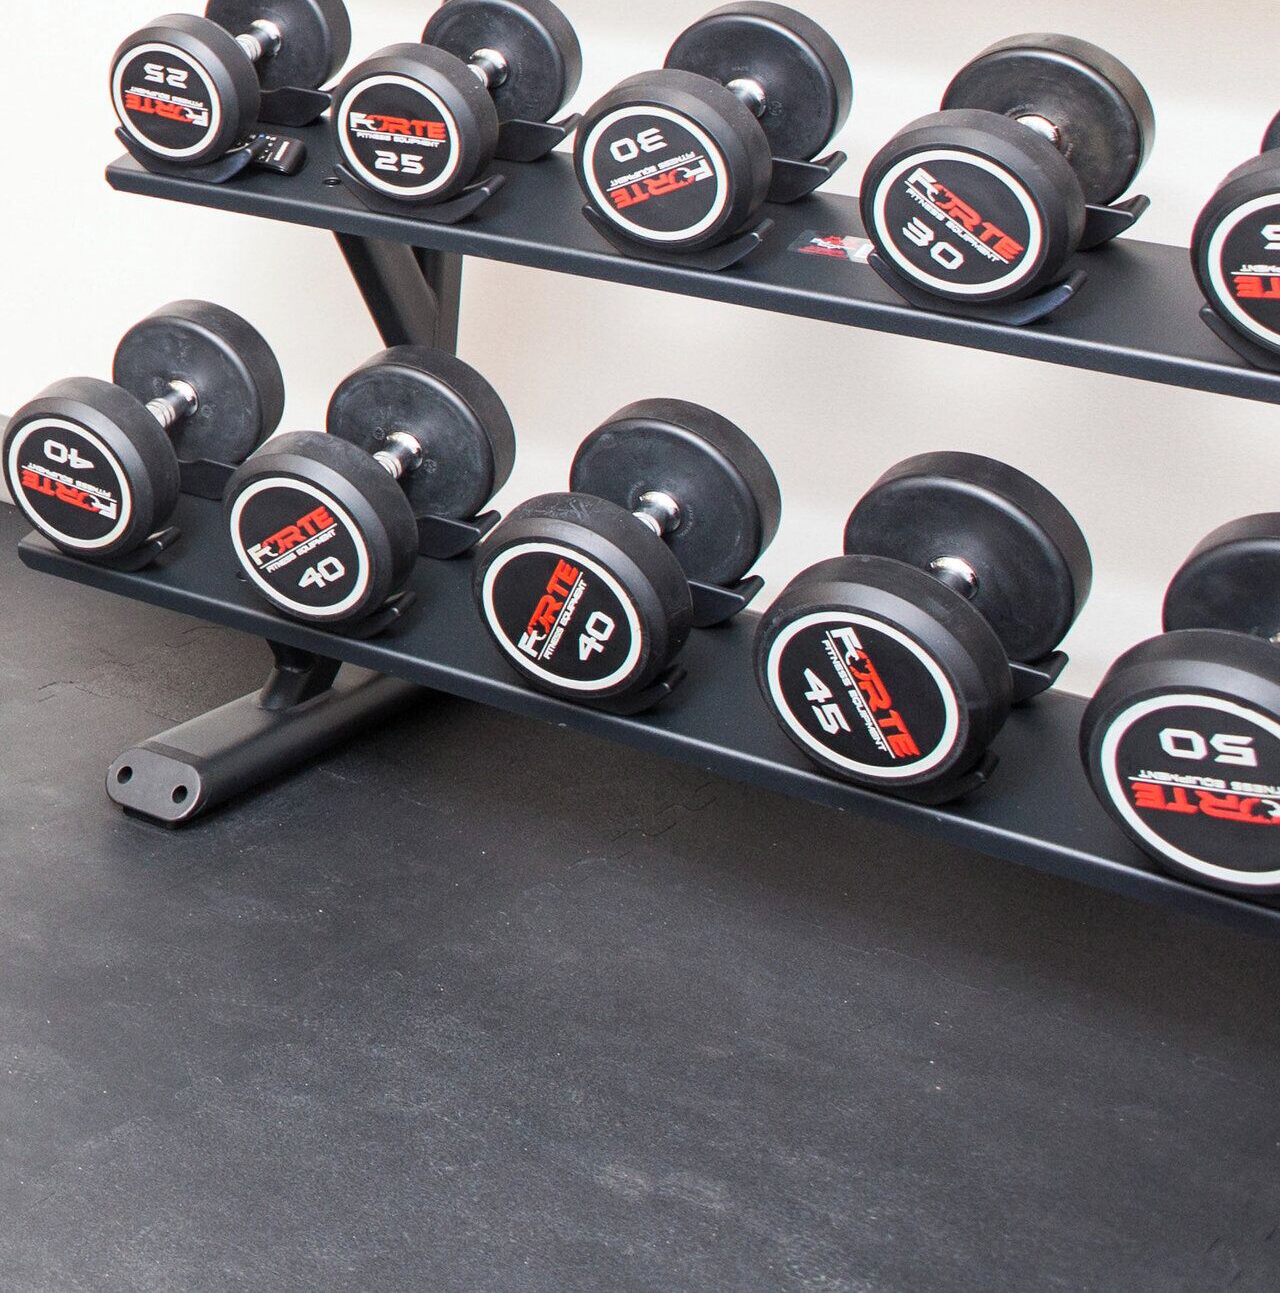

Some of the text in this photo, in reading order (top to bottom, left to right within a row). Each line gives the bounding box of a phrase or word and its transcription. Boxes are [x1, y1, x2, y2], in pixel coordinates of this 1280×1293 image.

[143, 62, 188, 89] 25
[124, 93, 209, 127] FORTE
[349, 111, 446, 140] FORTE
[374, 150, 425, 175] 25
[609, 127, 668, 163] 30
[610, 159, 714, 209] FORTE
[906, 167, 1025, 260] FORTE
[902, 216, 964, 270] 30
[43, 439, 95, 469] 40
[21, 469, 117, 520] FORTE
[246, 505, 334, 566] FORTE
[297, 556, 345, 588] 40
[517, 559, 579, 658] FORTE
[578, 611, 616, 661] 40
[803, 667, 852, 735] 45
[829, 626, 921, 758] FORTE
[1158, 727, 1258, 767] 50
[1131, 782, 1280, 825] ORTE
